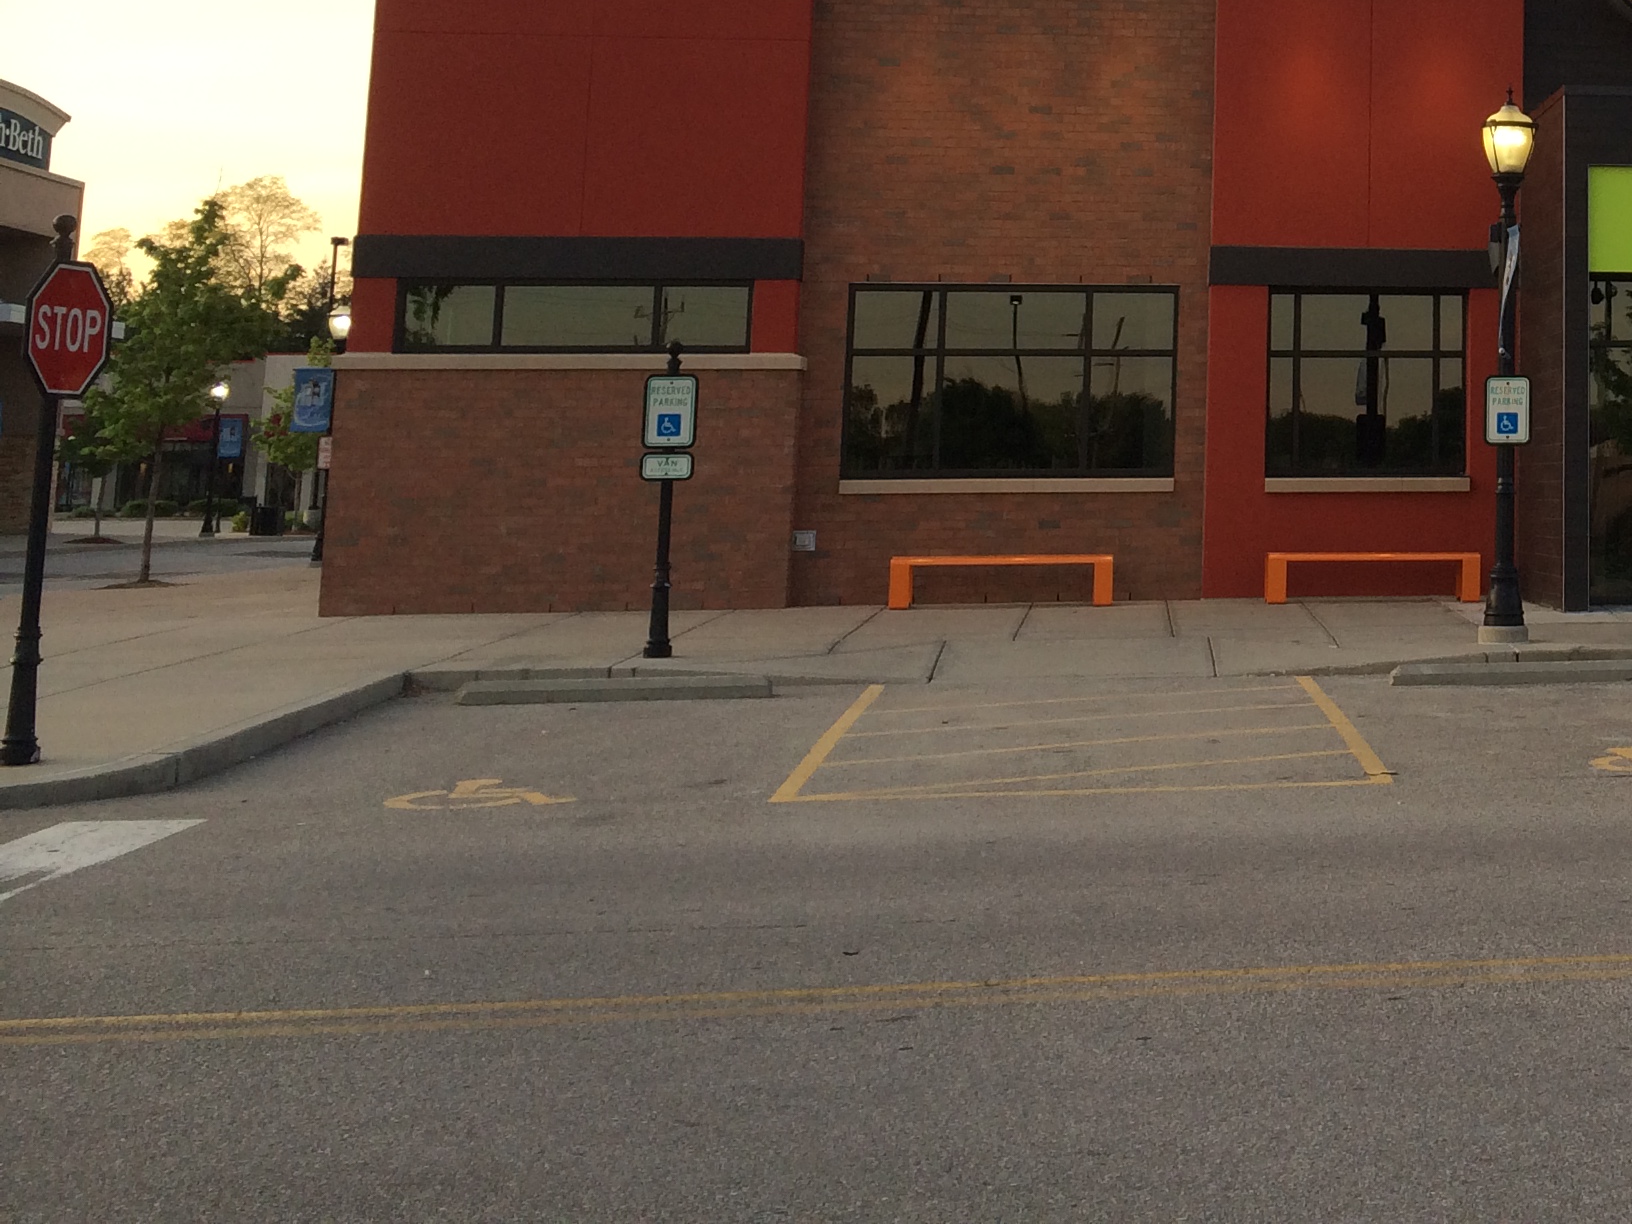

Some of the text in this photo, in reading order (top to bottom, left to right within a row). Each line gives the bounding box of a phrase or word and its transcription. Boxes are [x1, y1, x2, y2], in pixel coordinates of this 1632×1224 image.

[35, 304, 102, 353] STOP
[651, 386, 691, 396] RESERVED
[1490, 386, 1526, 395] RESERVED
[653, 397, 688, 407] PARKING
[1492, 397, 1524, 406] PARKING
[657, 460, 678, 468] VAN
